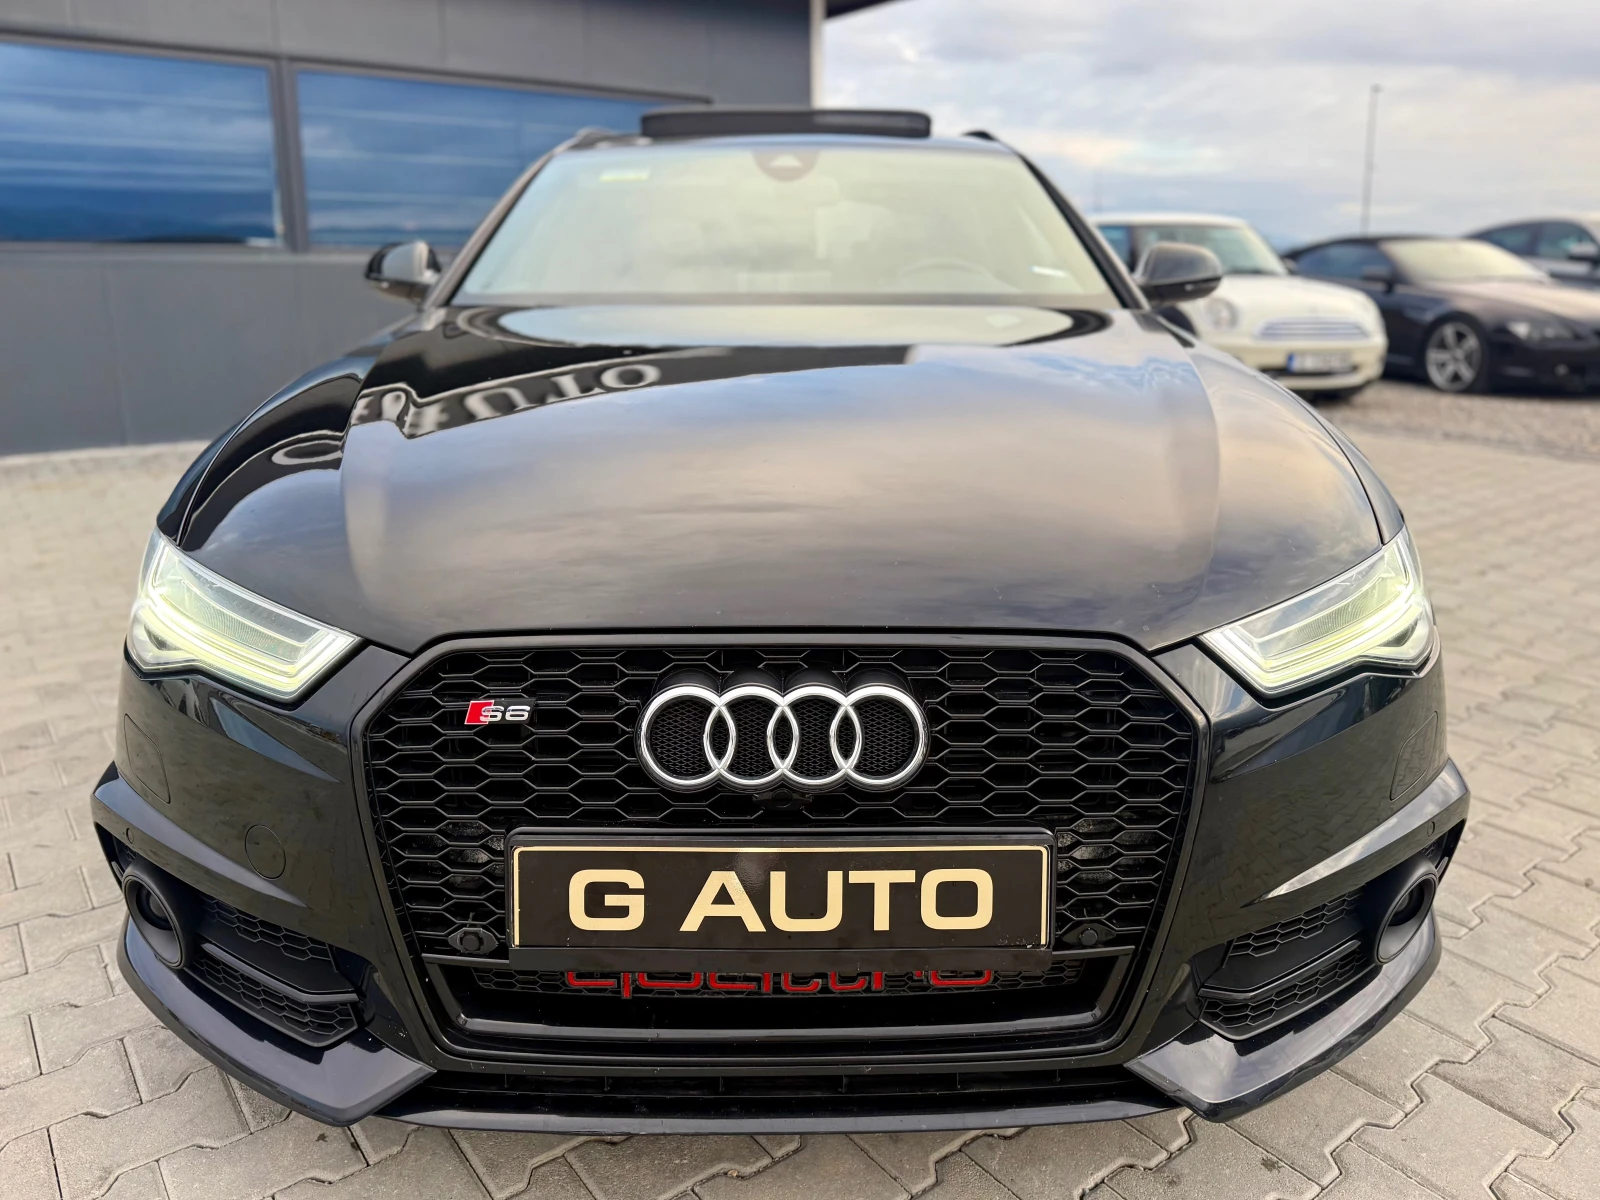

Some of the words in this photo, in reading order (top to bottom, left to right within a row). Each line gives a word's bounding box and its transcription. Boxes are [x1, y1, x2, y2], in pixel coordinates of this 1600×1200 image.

[479, 705, 531, 722] S6
[568, 869, 645, 931] G
[679, 868, 994, 932] AUTO
